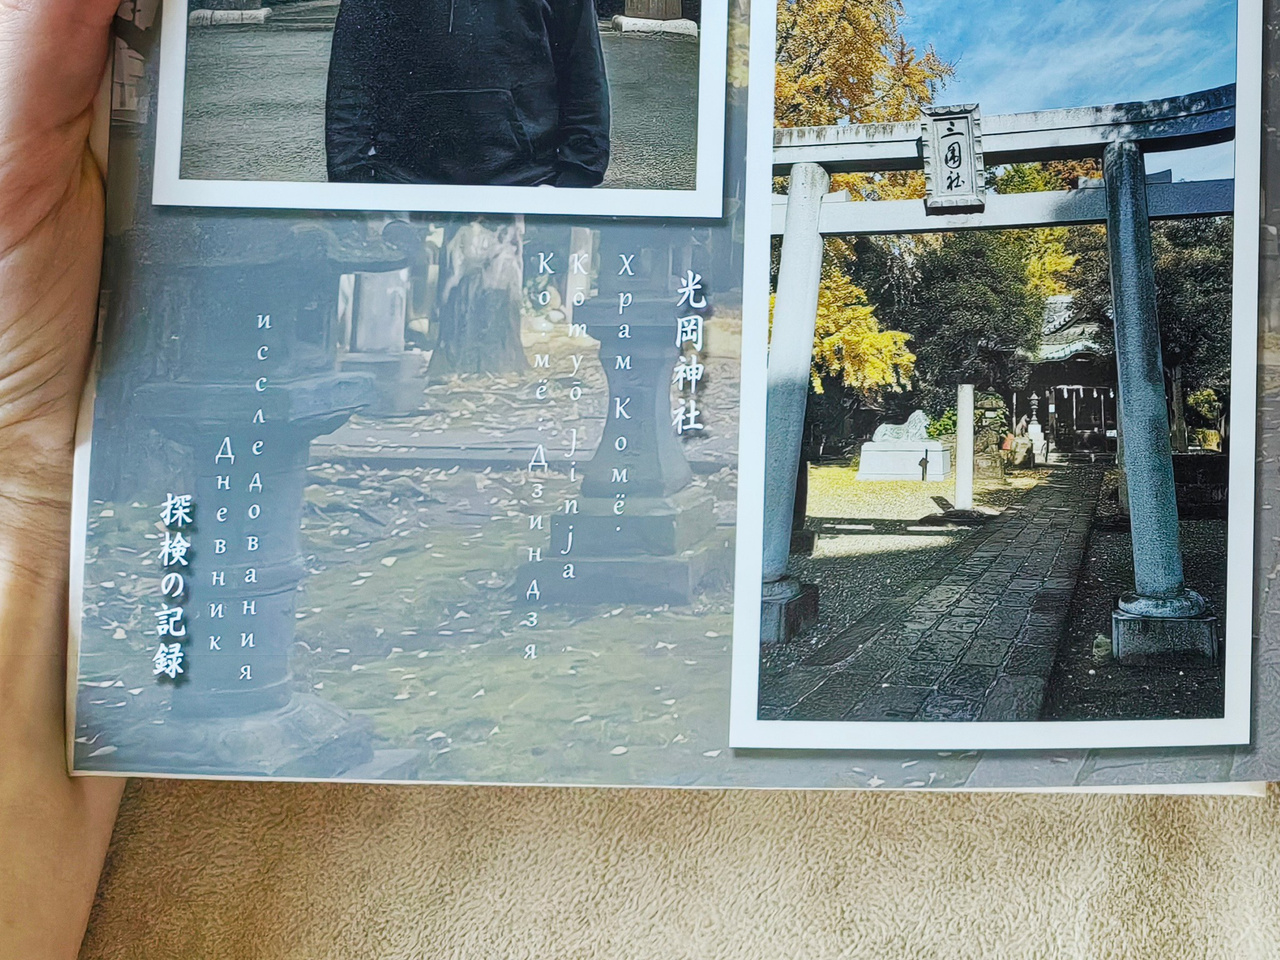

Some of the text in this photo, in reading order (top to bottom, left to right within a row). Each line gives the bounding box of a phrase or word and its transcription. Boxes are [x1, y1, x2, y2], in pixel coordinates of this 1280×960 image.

[561, 253, 588, 579] Kōmyō Jinja
[615, 254, 635, 370] Храм
[671, 269, 707, 436] 光岡神社
[152, 493, 193, 679] 探検の記録
[209, 436, 236, 651] Дневник
[238, 313, 272, 681] исследования
[524, 444, 548, 660] Дзиндзя
